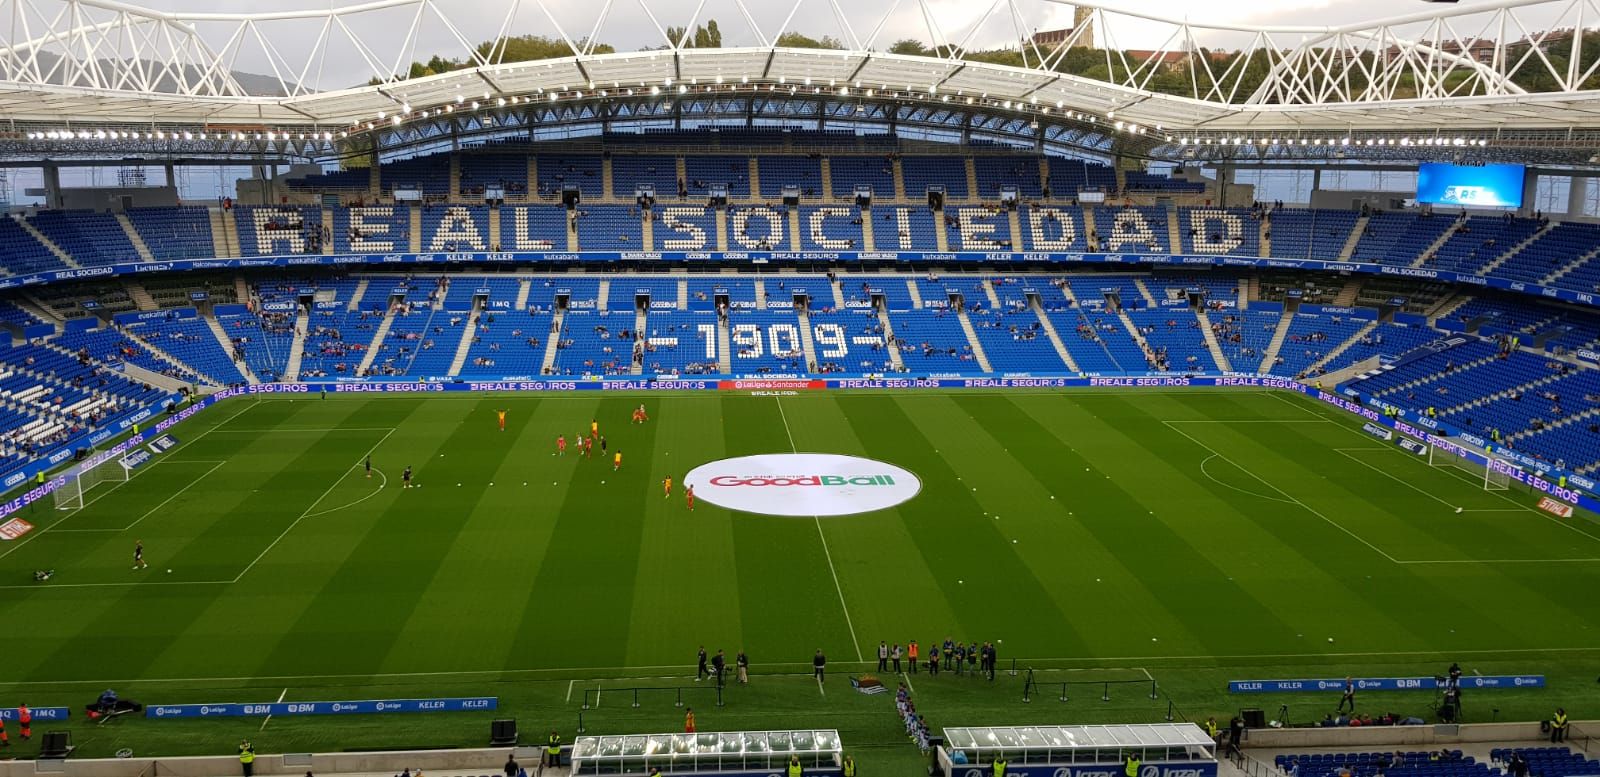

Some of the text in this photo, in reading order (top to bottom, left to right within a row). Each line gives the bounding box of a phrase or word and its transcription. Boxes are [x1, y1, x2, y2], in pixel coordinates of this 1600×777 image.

[252, 207, 1243, 253] REAL SOCIEDAD
[56, 271, 76, 279] REAL
[76, 267, 113, 277] SOCIEDAD
[1381, 266, 1438, 278] REAL SOCIEDAD
[1577, 293, 1593, 304] IMQ
[478, 382, 576, 390] REALE SEGUROS
[612, 382, 706, 390] REALE SEGUROS
[848, 380, 940, 388] REALE SEGUROS
[974, 379, 1064, 387] REALE SEGUROS
[1099, 378, 1190, 386] REALE SEGUROS
[1223, 378, 1306, 392] REALE SEGUROS
[218, 384, 308, 401] REALE SEGUROS
[345, 384, 444, 392] REALE SEGUROS
[1323, 392, 1379, 421] REALE SEGUROS
[160, 414, 180, 430] REALE
[1418, 416, 1438, 429] KELER
[112, 433, 144, 454] SEGUROS
[1400, 422, 1425, 440] REALE
[1426, 434, 1466, 458] SEGUROS
[1460, 432, 1485, 448] macron
[710, 475, 896, 486] GoodBall
[1492, 460, 1579, 504] REALE SEGUROS
[0, 474, 66, 519] EALE SEGUROS
[1540, 499, 1566, 516] STIHL
[1238, 682, 1262, 690] KELER
[1406, 680, 1421, 688] BM
[254, 705, 271, 714] BM
[298, 704, 315, 712] BM
[418, 701, 445, 709] KELER
[462, 700, 488, 708] KELER
[35, 710, 56, 718] IMQ
